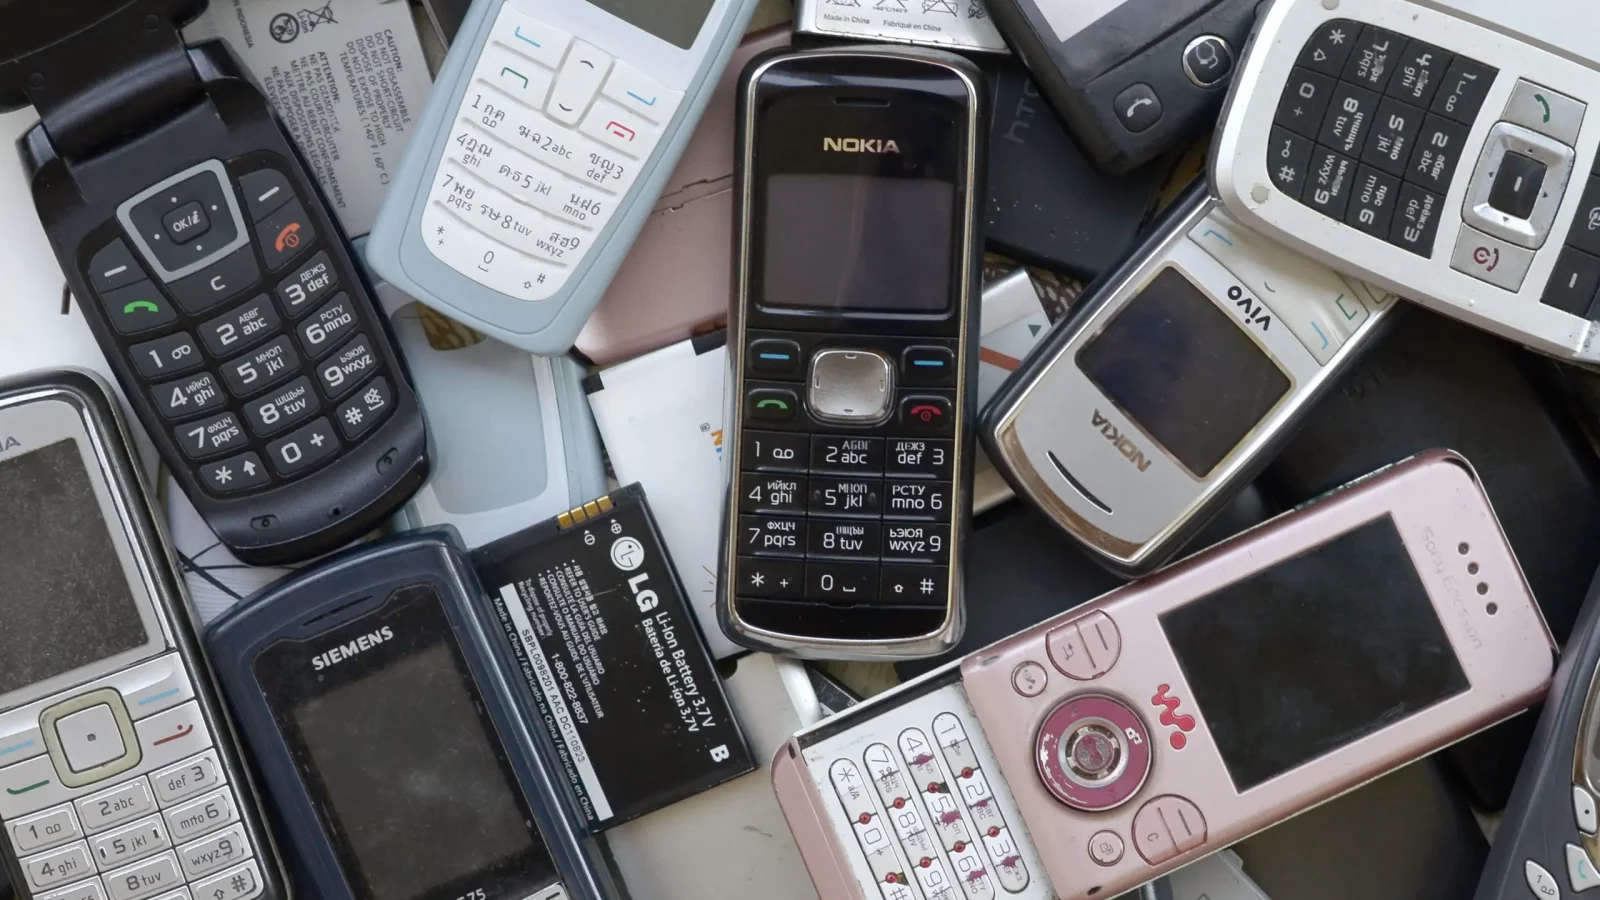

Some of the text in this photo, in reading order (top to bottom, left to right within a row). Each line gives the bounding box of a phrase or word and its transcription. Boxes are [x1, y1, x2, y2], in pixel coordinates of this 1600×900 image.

[236, 7, 254, 48] INDONESIA
[824, 14, 842, 22] Made
[852, 16, 870, 24] China
[883, 20, 912, 30] Fabriqué
[922, 24, 942, 32] Chine
[383, 27, 404, 72] CAUTION:
[1358, 50, 1373, 76] pqrs
[312, 66, 324, 83] PAS
[316, 49, 341, 104] ATTENTION:
[338, 51, 366, 116] TEMPERATURES
[355, 37, 391, 130] DISPOSE PROPERLY
[1402, 67, 1415, 87] ghi
[369, 50, 403, 133] NOT SHORT-CIRCUIT
[379, 46, 411, 124] NOT DISASSEMBLE
[274, 78, 286, 95] PAS
[280, 95, 298, 132] EXPOSER
[350, 56, 387, 146] NOT EXPOSE HIGH
[303, 69, 340, 161] PAS COURT-CIRCUITER
[281, 70, 294, 88] AUX
[288, 89, 314, 148] DISPOSITIONS
[308, 148, 327, 187] LEGALES
[288, 59, 346, 209] METTRE REBUT CONFORMEMENT
[1334, 116, 1347, 136] tuv
[552, 144, 572, 159] abc
[824, 137, 900, 154] NOKIA
[1378, 135, 1390, 152] jkl
[462, 154, 481, 168] ghi
[1319, 155, 1335, 184] wxyz
[1418, 150, 1432, 172] abc
[1430, 154, 1446, 181] абвг
[585, 169, 607, 185] def
[534, 182, 551, 196] jkl
[1361, 176, 1376, 202] mno
[1374, 185, 1388, 207] прс
[447, 194, 472, 211] pqrs
[1406, 200, 1419, 220] def
[563, 205, 586, 222] mno
[514, 221, 532, 236] tuv
[536, 239, 564, 257] wxyz
[300, 263, 326, 281] ДЕЖЗ
[286, 273, 328, 304] 3 def
[239, 308, 260, 324] АБВГ
[320, 305, 343, 322] РСТУ
[1227, 285, 1272, 332] vivo
[216, 318, 266, 345] 2 abc
[306, 314, 351, 344] 6 mno
[256, 346, 282, 364] МНОП
[237, 357, 284, 383] 5 jkl
[325, 355, 372, 386] 9 wxyz
[185, 376, 210, 394] ИЙКЛ
[171, 386, 214, 407] 4 ghi
[260, 398, 305, 424] 8 tuv
[207, 418, 232, 434] ФХЦЧ
[188, 426, 238, 448] 7 pqrs
[1091, 408, 1152, 473] NOKIA
[826, 446, 866, 464] 2 abc
[898, 449, 944, 464] def 3
[749, 486, 792, 505] 4 ghi
[767, 480, 796, 491] ИЙКЛ
[892, 485, 926, 496] РСТУ
[826, 490, 862, 509] 5 jkl
[892, 494, 942, 509] mno 6
[767, 522, 796, 531] ФХЦЧ
[890, 528, 922, 538] ЬЭЮЯ
[749, 528, 795, 547] 7 pqrs
[824, 533, 862, 550] 8 tuv
[890, 536, 940, 553] wxyz 9
[627, 571, 660, 613] LG
[545, 572, 566, 607] CONSULTE
[563, 613, 582, 644] MANUAL
[554, 569, 574, 604] CONSULTE
[581, 630, 592, 645] DEL
[563, 566, 601, 641] REFER USER'S GUIDE
[1443, 575, 1483, 649] Ercsson
[312, 626, 394, 670] SIEMENS
[537, 576, 605, 719] REPORTEZ-VOUS GUIDE L'UTILISATEUR
[654, 610, 702, 699] Li-Ion Battery
[641, 617, 666, 658] Bateria
[658, 657, 673, 674] de
[678, 706, 699, 735] 3,7V
[521, 628, 586, 763] SBPL0098201 AAC DC110823
[550, 652, 588, 726] 1-800-822-8837
[492, 596, 595, 822] Made China Fabricado China Fabricado China
[709, 743, 731, 764] B
[907, 738, 922, 752] 4
[168, 775, 186, 790] def
[966, 782, 984, 798] 2
[114, 798, 134, 811] abc
[180, 815, 204, 829] mno
[898, 812, 916, 828] 8
[131, 835, 146, 851] jkl
[192, 840, 232, 866] wxyz 9
[42, 858, 76, 876] 4 ghi
[958, 856, 976, 872] 6
[126, 873, 160, 890] 8 tuv
[924, 871, 942, 887] 9
